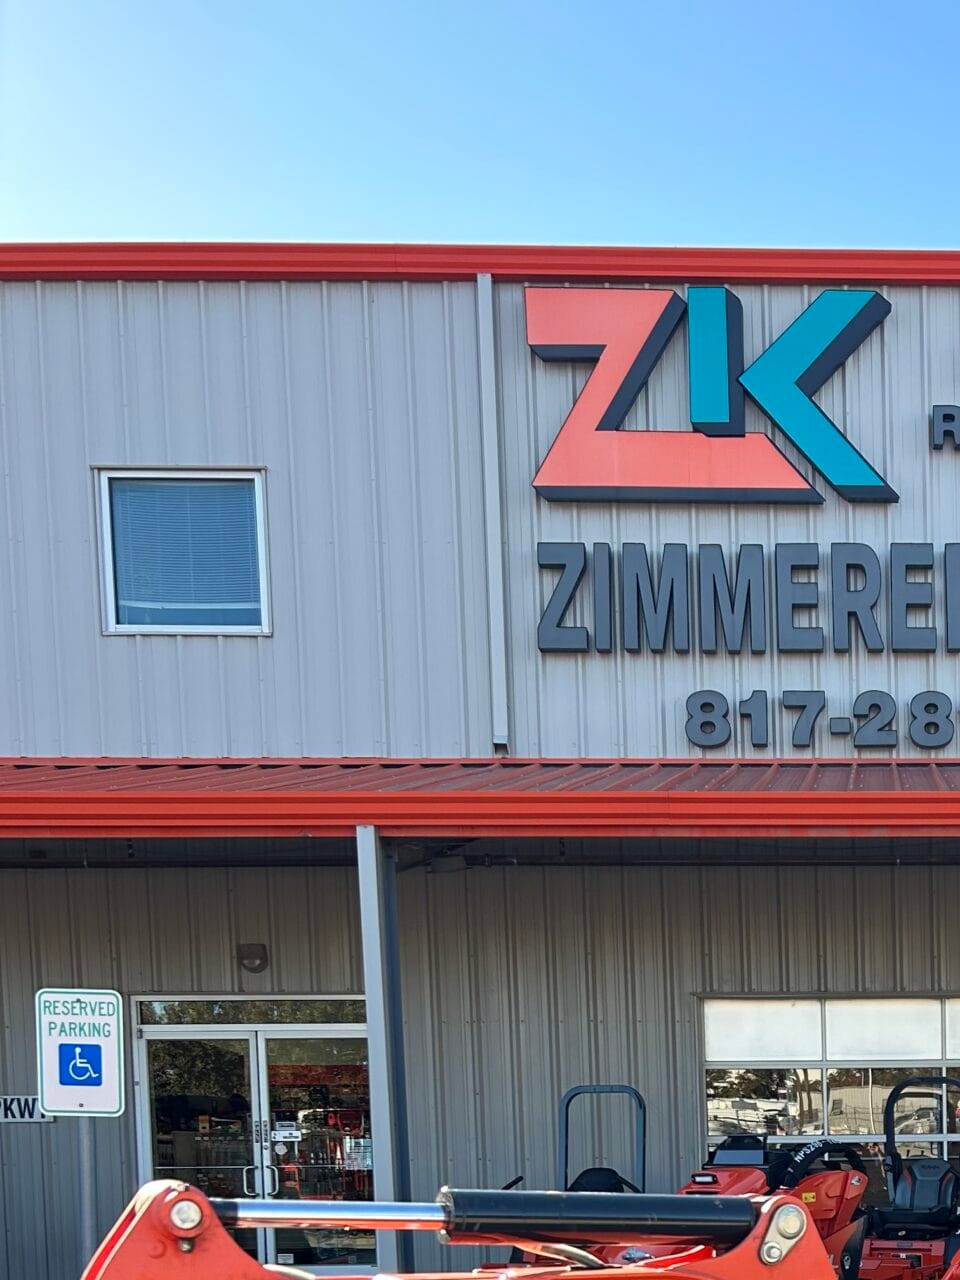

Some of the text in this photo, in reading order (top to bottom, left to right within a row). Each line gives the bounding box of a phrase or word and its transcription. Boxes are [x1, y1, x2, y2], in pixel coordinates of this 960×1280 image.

[525, 286, 898, 503] ZK
[43, 1000, 116, 1017] RESERVED
[48, 1021, 111, 1038] PARKING
